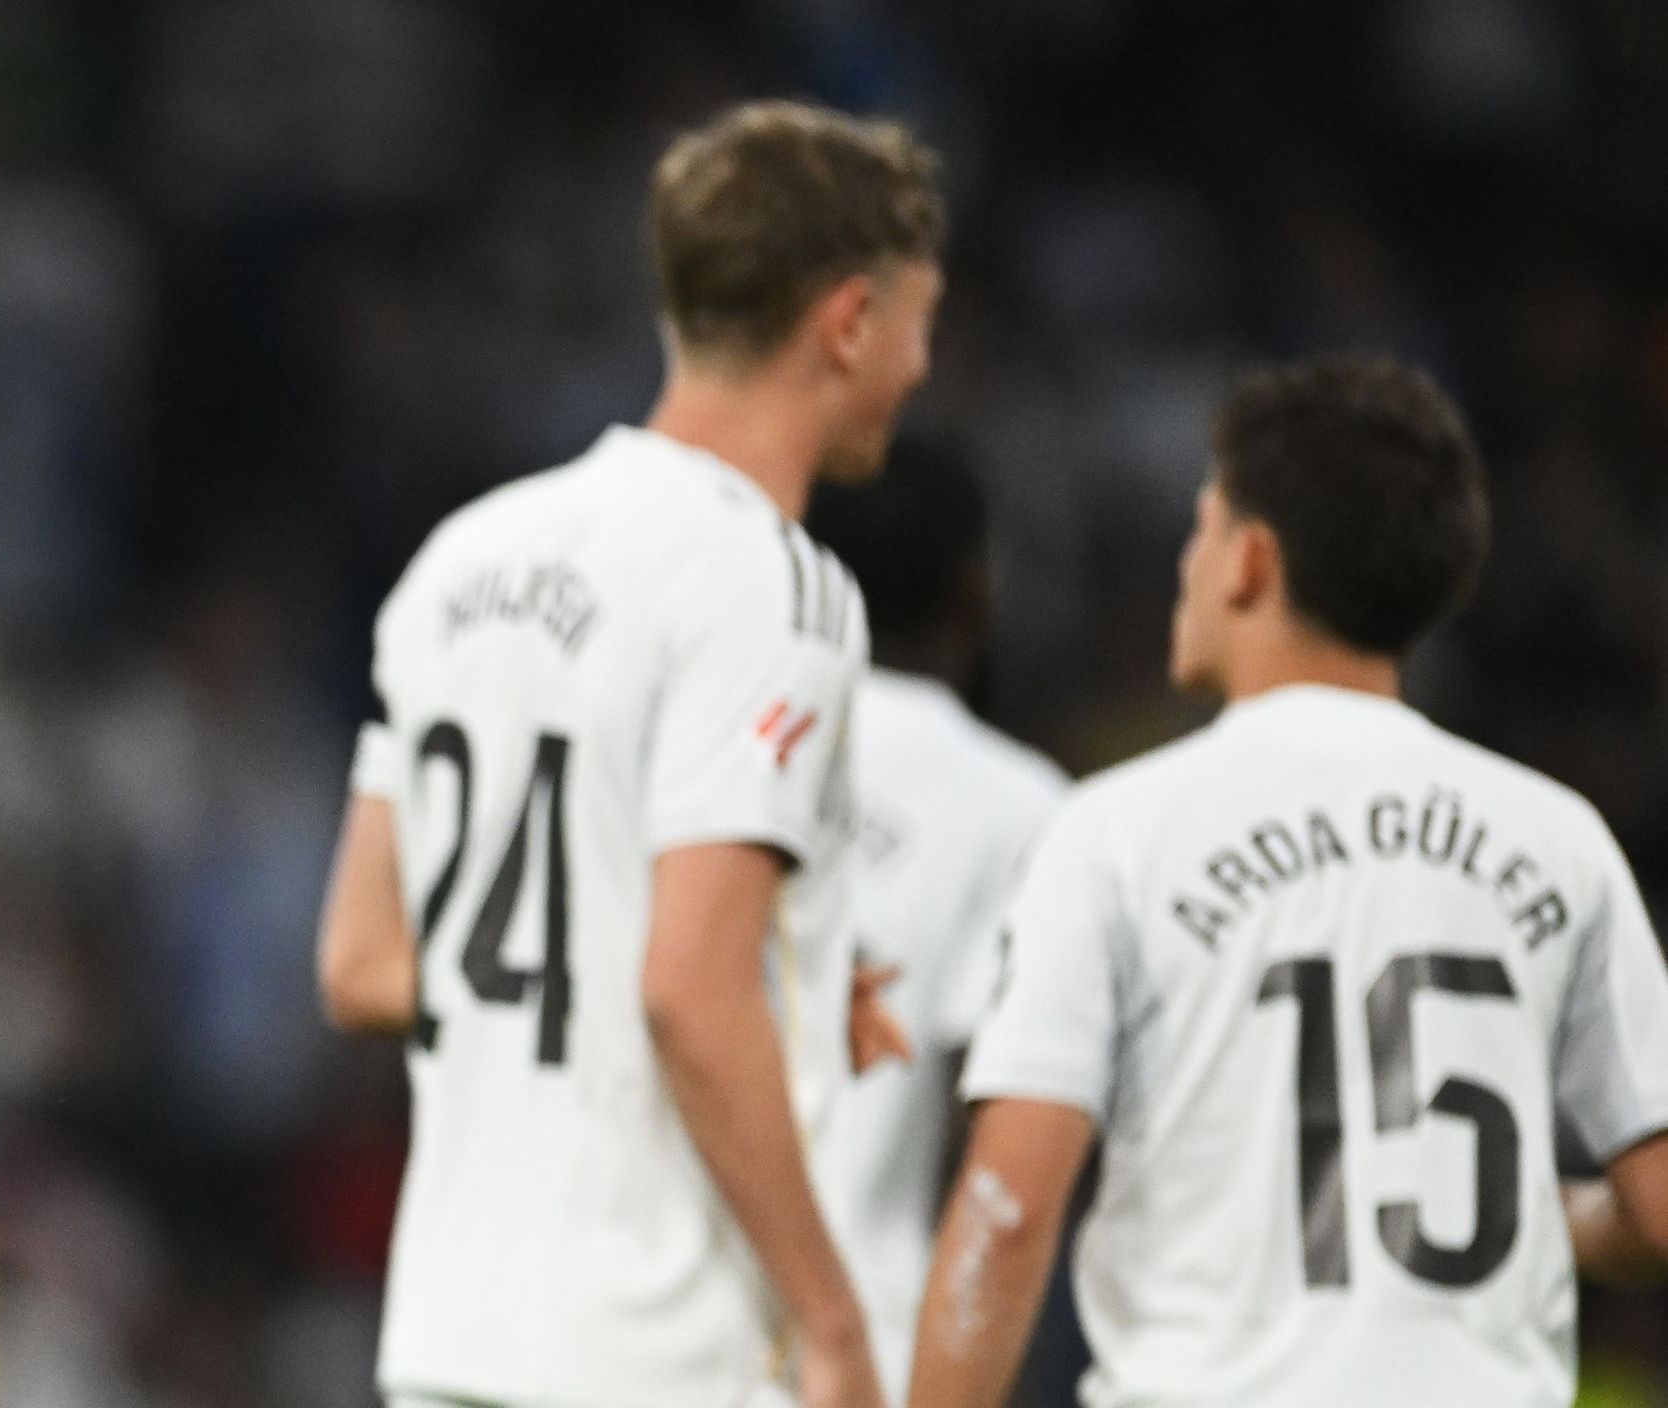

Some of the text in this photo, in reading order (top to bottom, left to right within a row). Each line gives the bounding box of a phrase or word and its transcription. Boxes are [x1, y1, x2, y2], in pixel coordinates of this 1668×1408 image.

[415, 720, 572, 1067] 24
[1172, 784, 1574, 953] ARDA GÜLER
[1256, 951, 1522, 1292] 15
